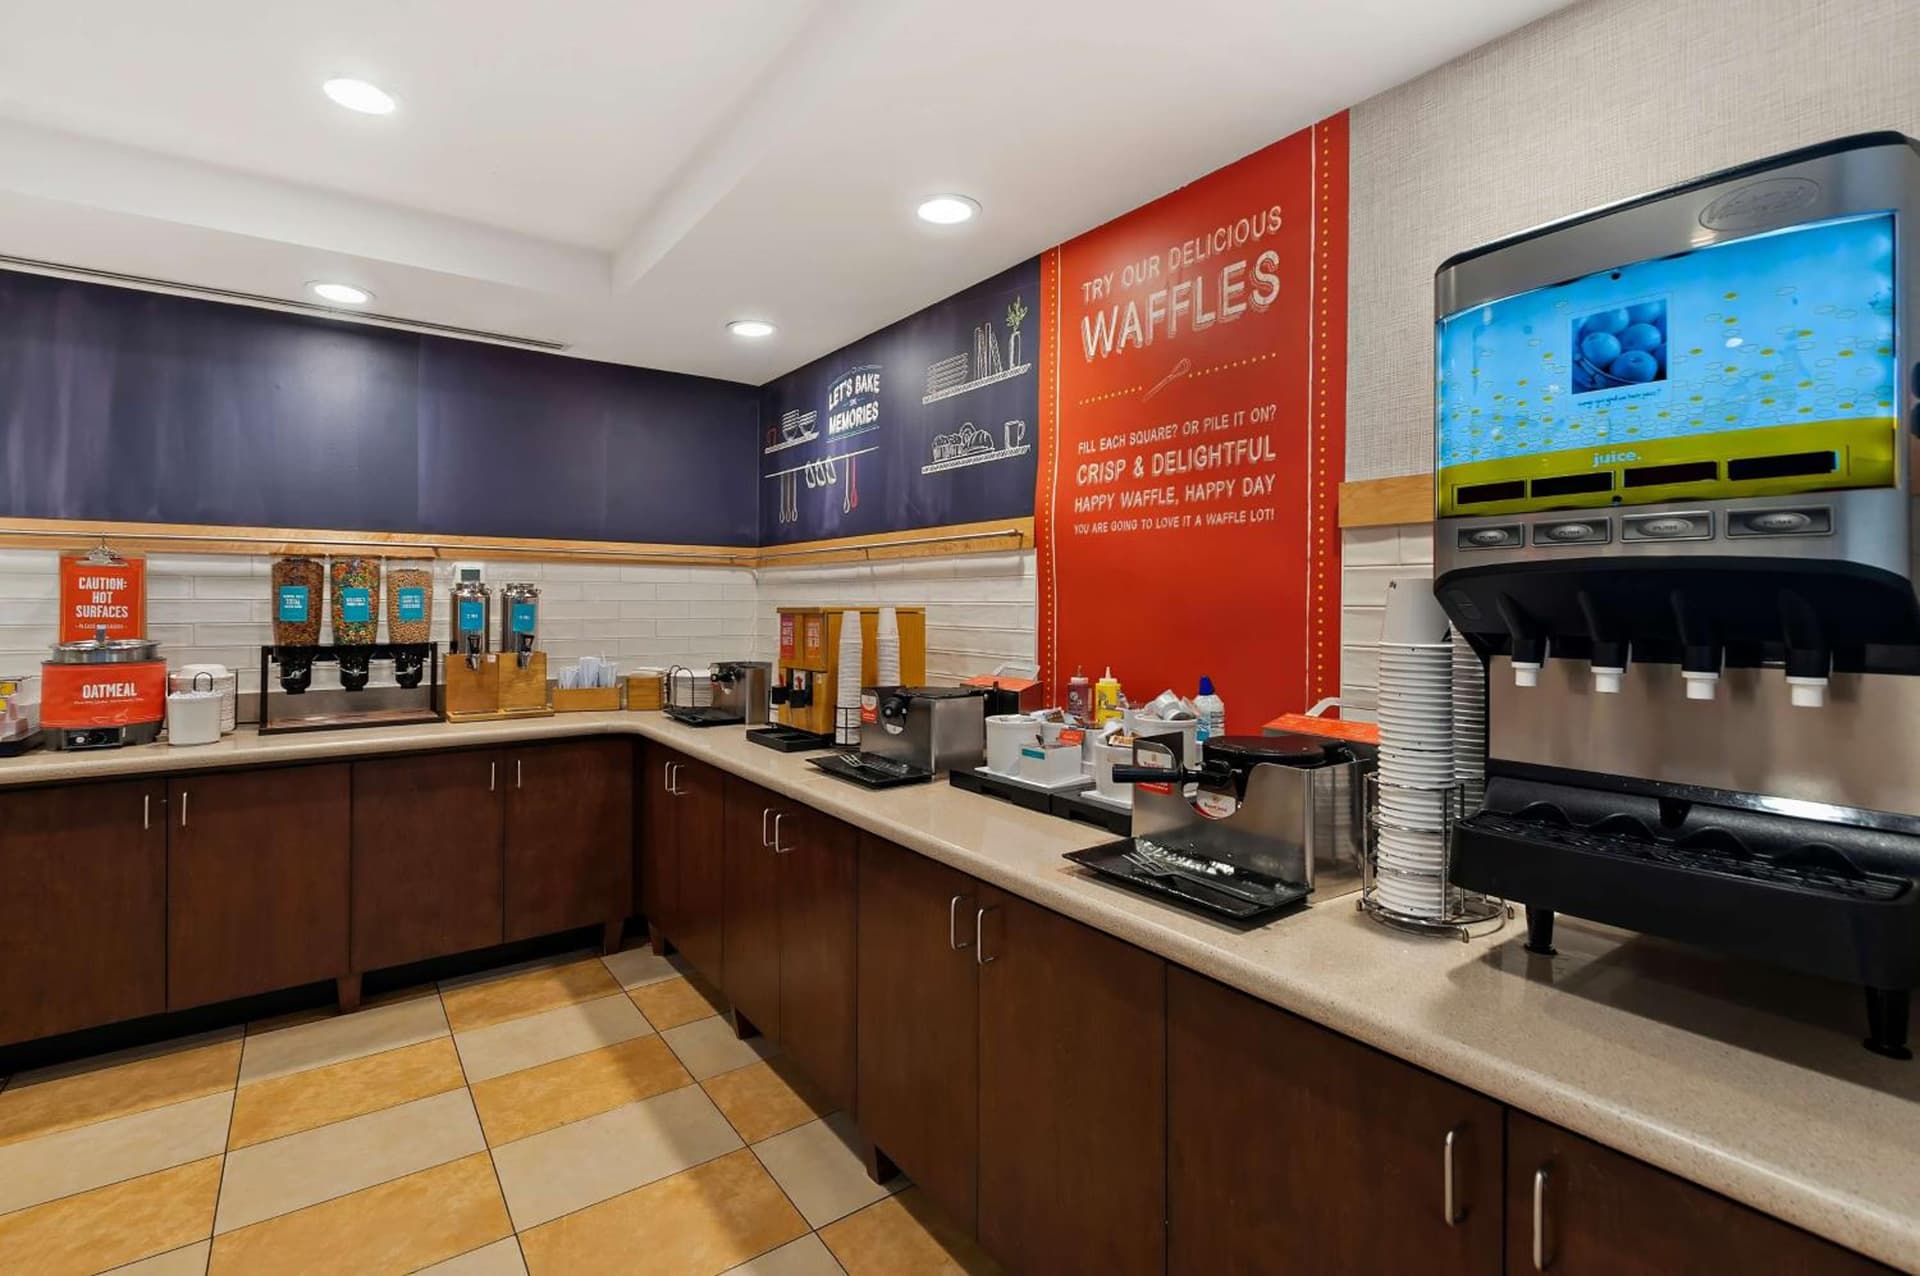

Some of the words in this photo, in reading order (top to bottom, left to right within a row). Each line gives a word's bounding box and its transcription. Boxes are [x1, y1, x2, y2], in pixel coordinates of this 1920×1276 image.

[1081, 274, 1113, 304] TRY
[1122, 255, 1161, 288] OUR
[1168, 205, 1282, 271] DELICIOUS
[1081, 250, 1281, 361] WAFFLES
[829, 378, 853, 411] LET'S
[855, 373, 880, 394] BAKE
[829, 401, 879, 435] MEMORIES
[1078, 439, 1097, 455] FILL
[1100, 433, 1126, 453] EACH
[1129, 423, 1178, 447] SQUARE?
[1182, 419, 1199, 435] OR
[1203, 414, 1229, 433] PILE
[1234, 410, 1245, 427] IT
[1250, 404, 1277, 423] ON?
[1076, 458, 1126, 486] CRISP
[1133, 455, 1144, 478] &
[1151, 434, 1277, 477] DELIGHTFUL
[1592, 450, 1642, 468] juice.
[1074, 492, 1115, 513] HAPPY
[1121, 486, 1180, 509] WAFFLE,
[1185, 479, 1236, 501] HAPPY
[1242, 473, 1276, 498] DAY
[1074, 523, 1089, 535] YOU
[1091, 521, 1109, 534] ARE
[1111, 519, 1138, 532] GOING
[1142, 517, 1153, 530] TO
[1156, 515, 1180, 529] LOVE
[1182, 514, 1191, 527] IT
[1195, 512, 1202, 527] A
[1206, 509, 1246, 526] WAFFLE
[1250, 507, 1275, 522] LOT!
[78, 576, 128, 590] CAUTION:
[92, 591, 113, 604] HOT
[75, 605, 129, 618] SURFACES
[82, 682, 138, 699] OATMEAL
